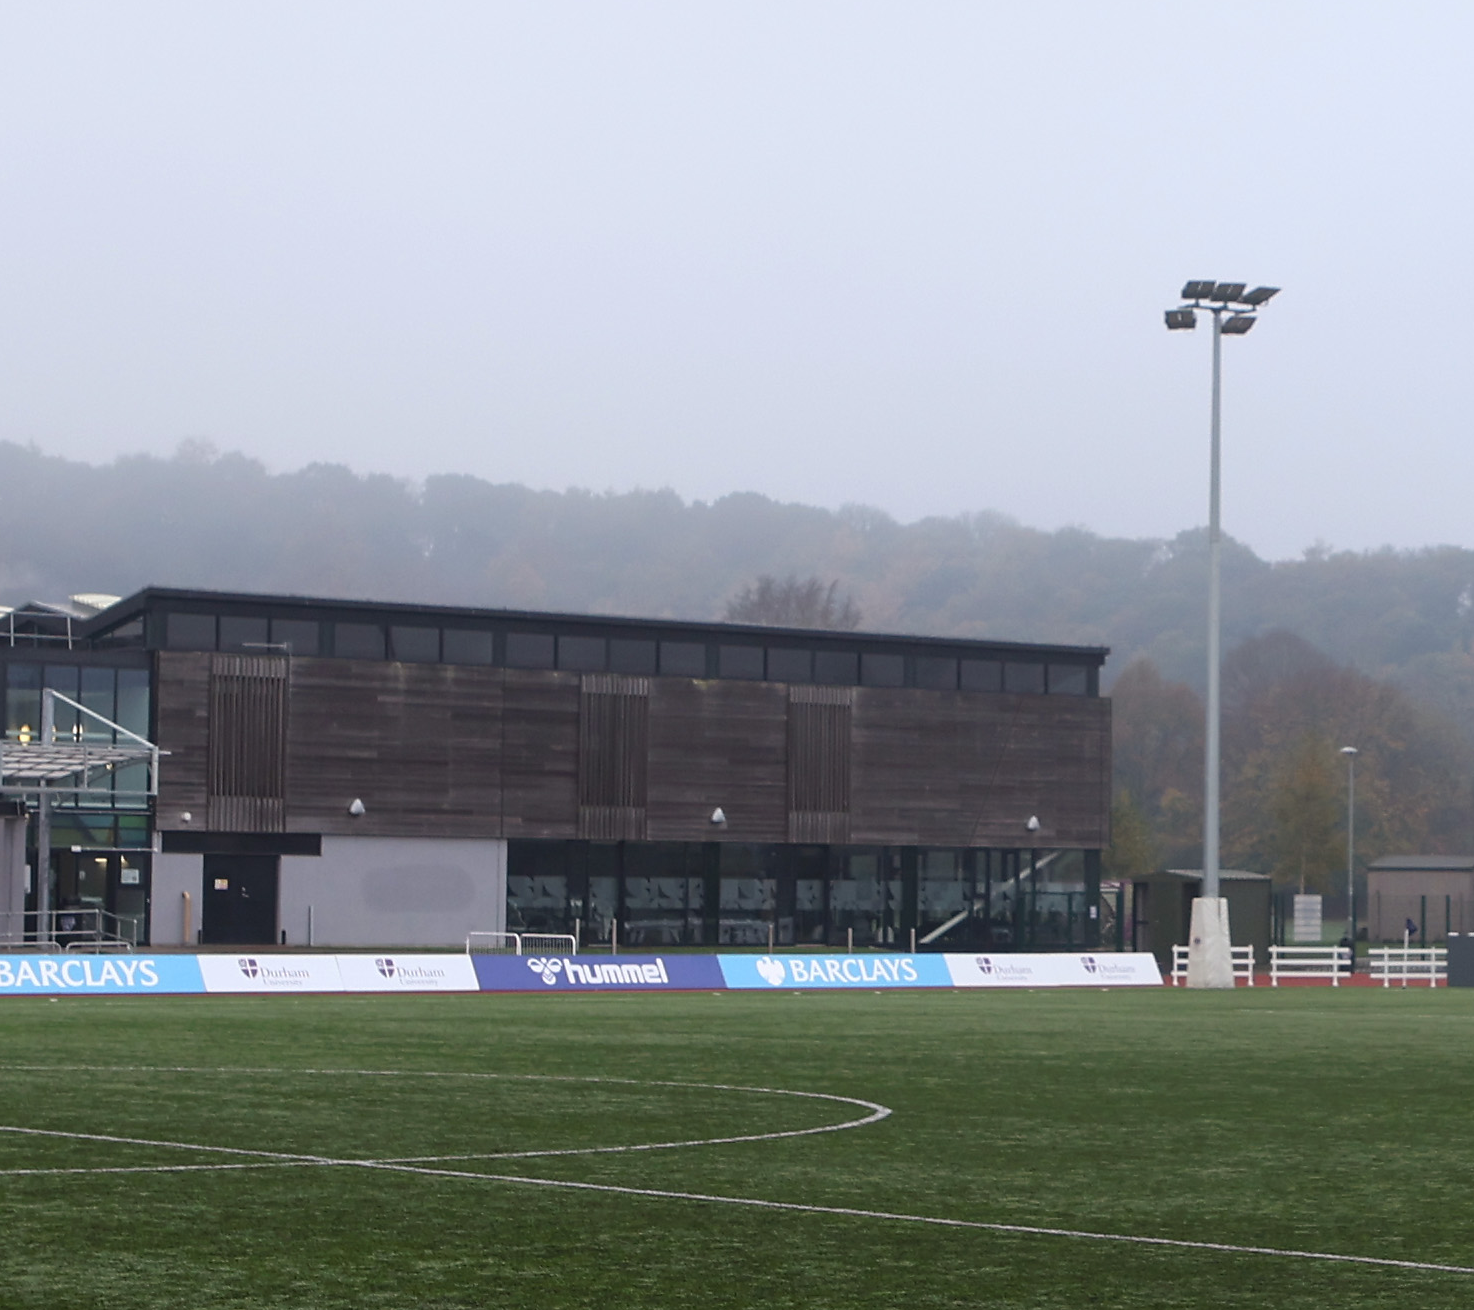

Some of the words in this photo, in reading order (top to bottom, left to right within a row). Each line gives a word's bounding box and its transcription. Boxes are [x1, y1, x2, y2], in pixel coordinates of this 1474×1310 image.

[259, 966, 310, 978] Durham
[396, 966, 445, 978] Durham
[562, 957, 669, 984] hummel
[789, 958, 918, 983] BARCLAYS
